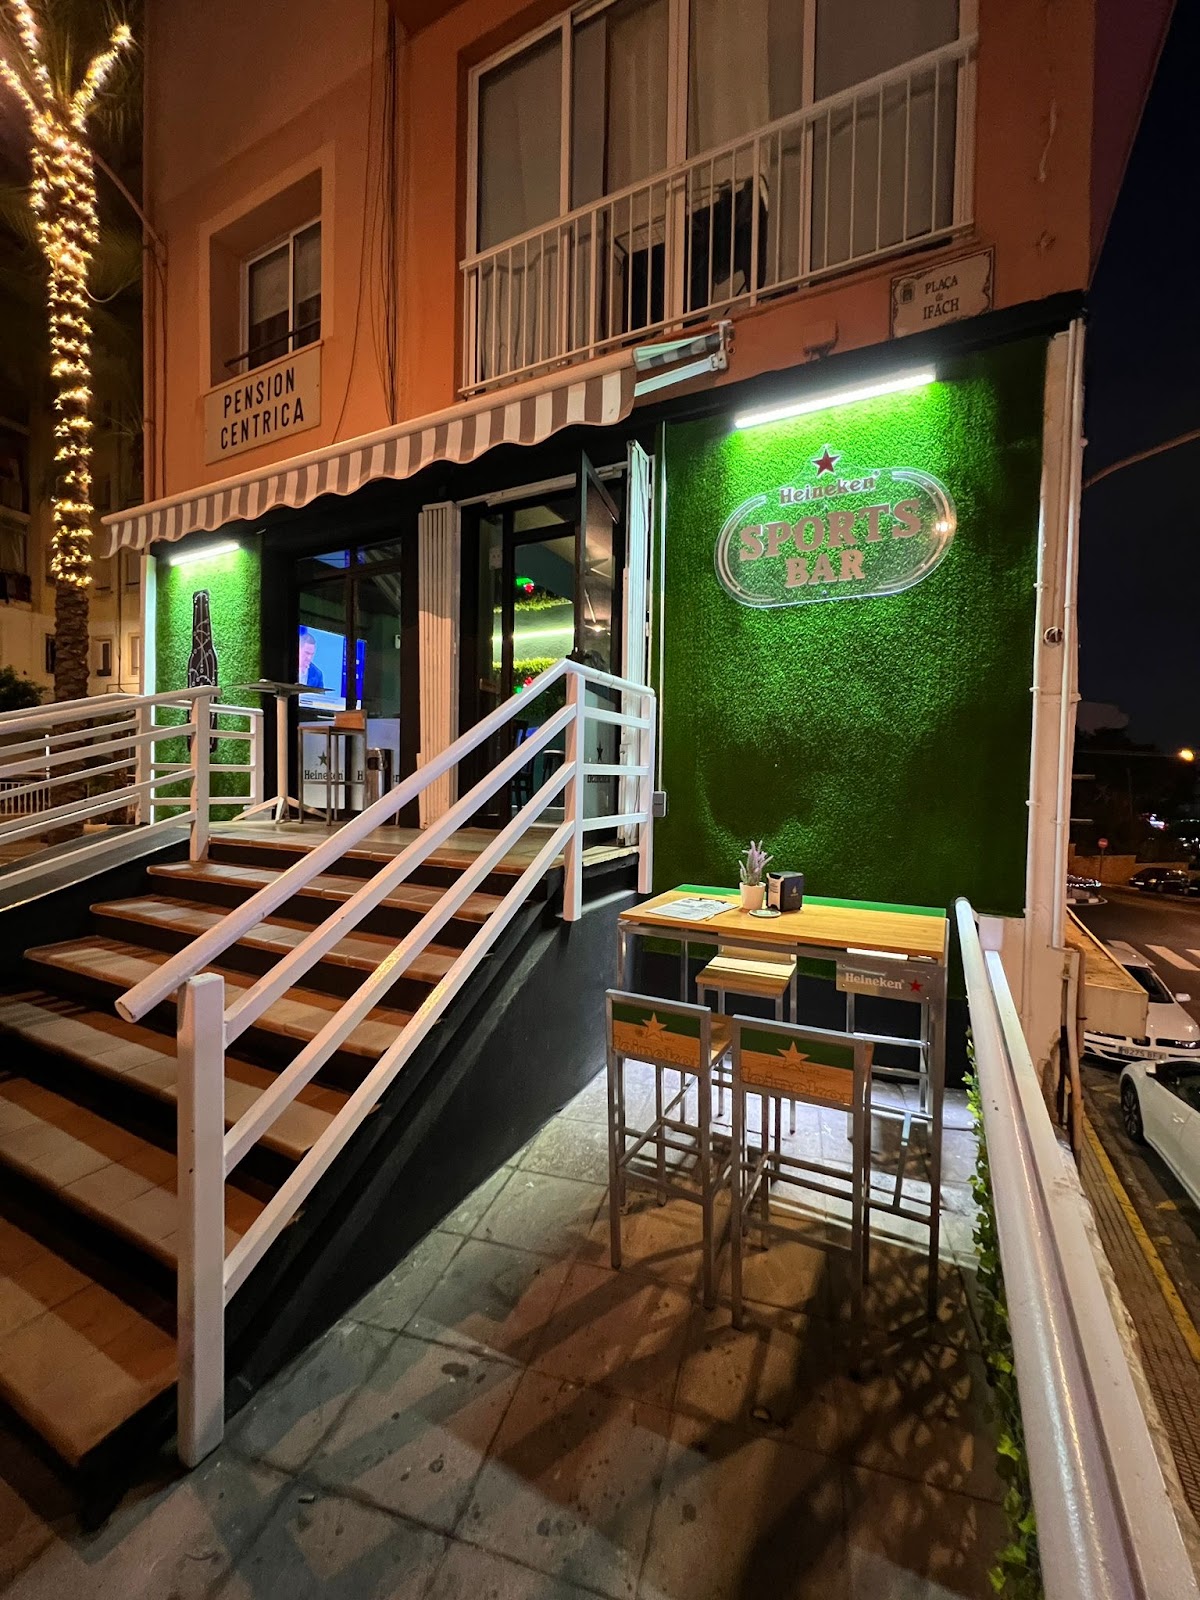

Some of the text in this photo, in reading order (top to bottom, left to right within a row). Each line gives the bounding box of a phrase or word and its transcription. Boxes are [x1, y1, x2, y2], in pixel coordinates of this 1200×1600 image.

[925, 275, 958, 294] PLAÇA
[923, 298, 960, 320] IFACH
[224, 367, 295, 418] PENSION
[221, 397, 304, 450] CENTRICA
[780, 475, 876, 506] Heineken
[739, 499, 922, 561] SPORTS
[785, 549, 865, 588] BAR
[845, 972, 903, 990] Heineken
